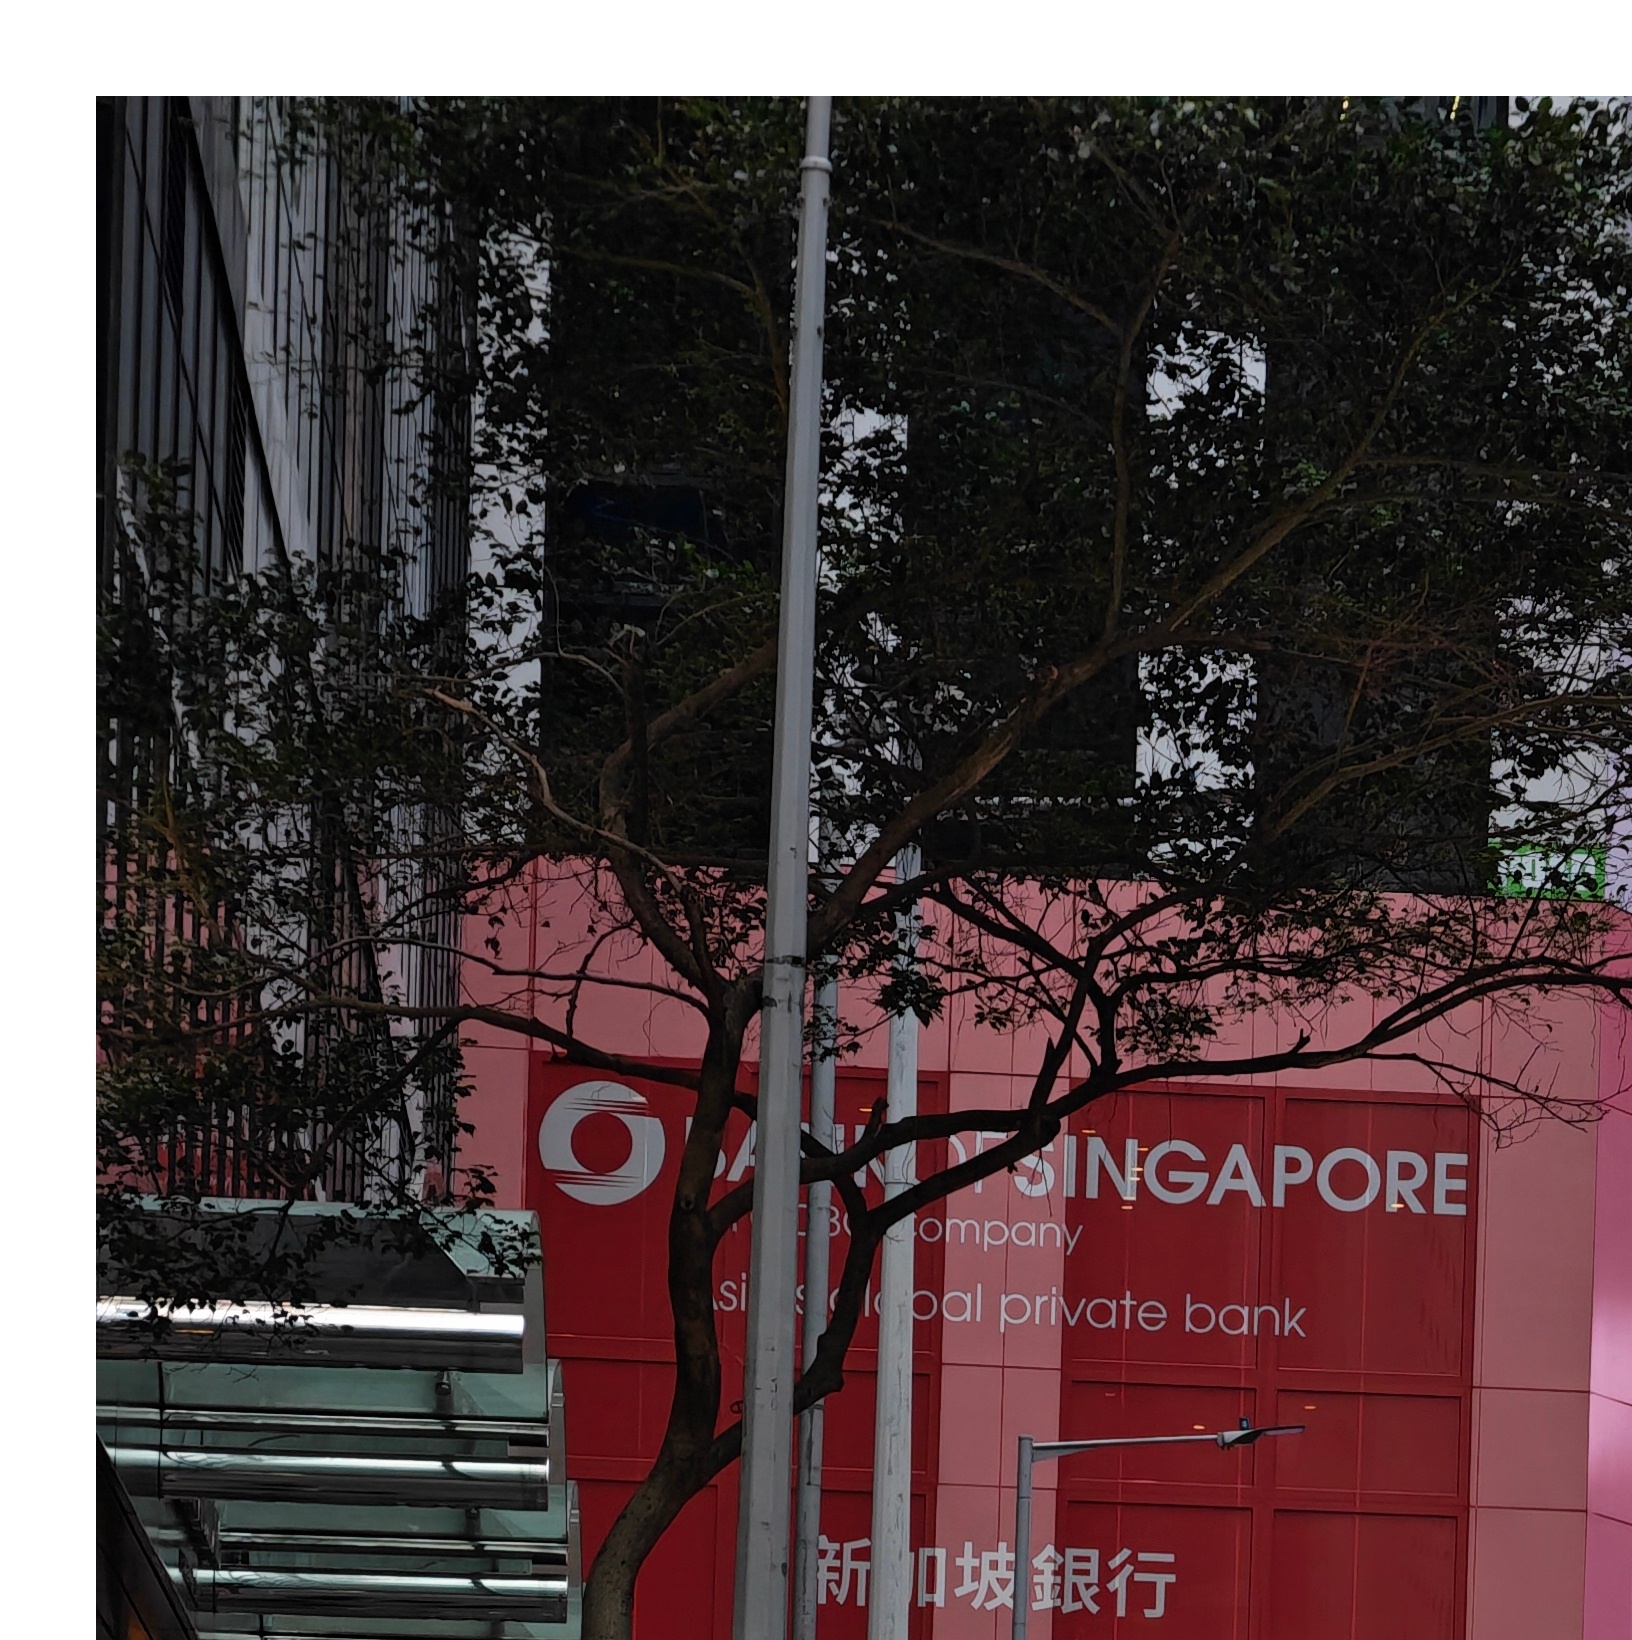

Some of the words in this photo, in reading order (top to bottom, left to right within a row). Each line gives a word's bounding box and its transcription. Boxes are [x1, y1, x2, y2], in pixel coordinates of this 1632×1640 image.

[1012, 1134, 1469, 1216] SINGAPORE
[999, 1287, 1168, 1333] private
[1185, 1293, 1307, 1338] bank
